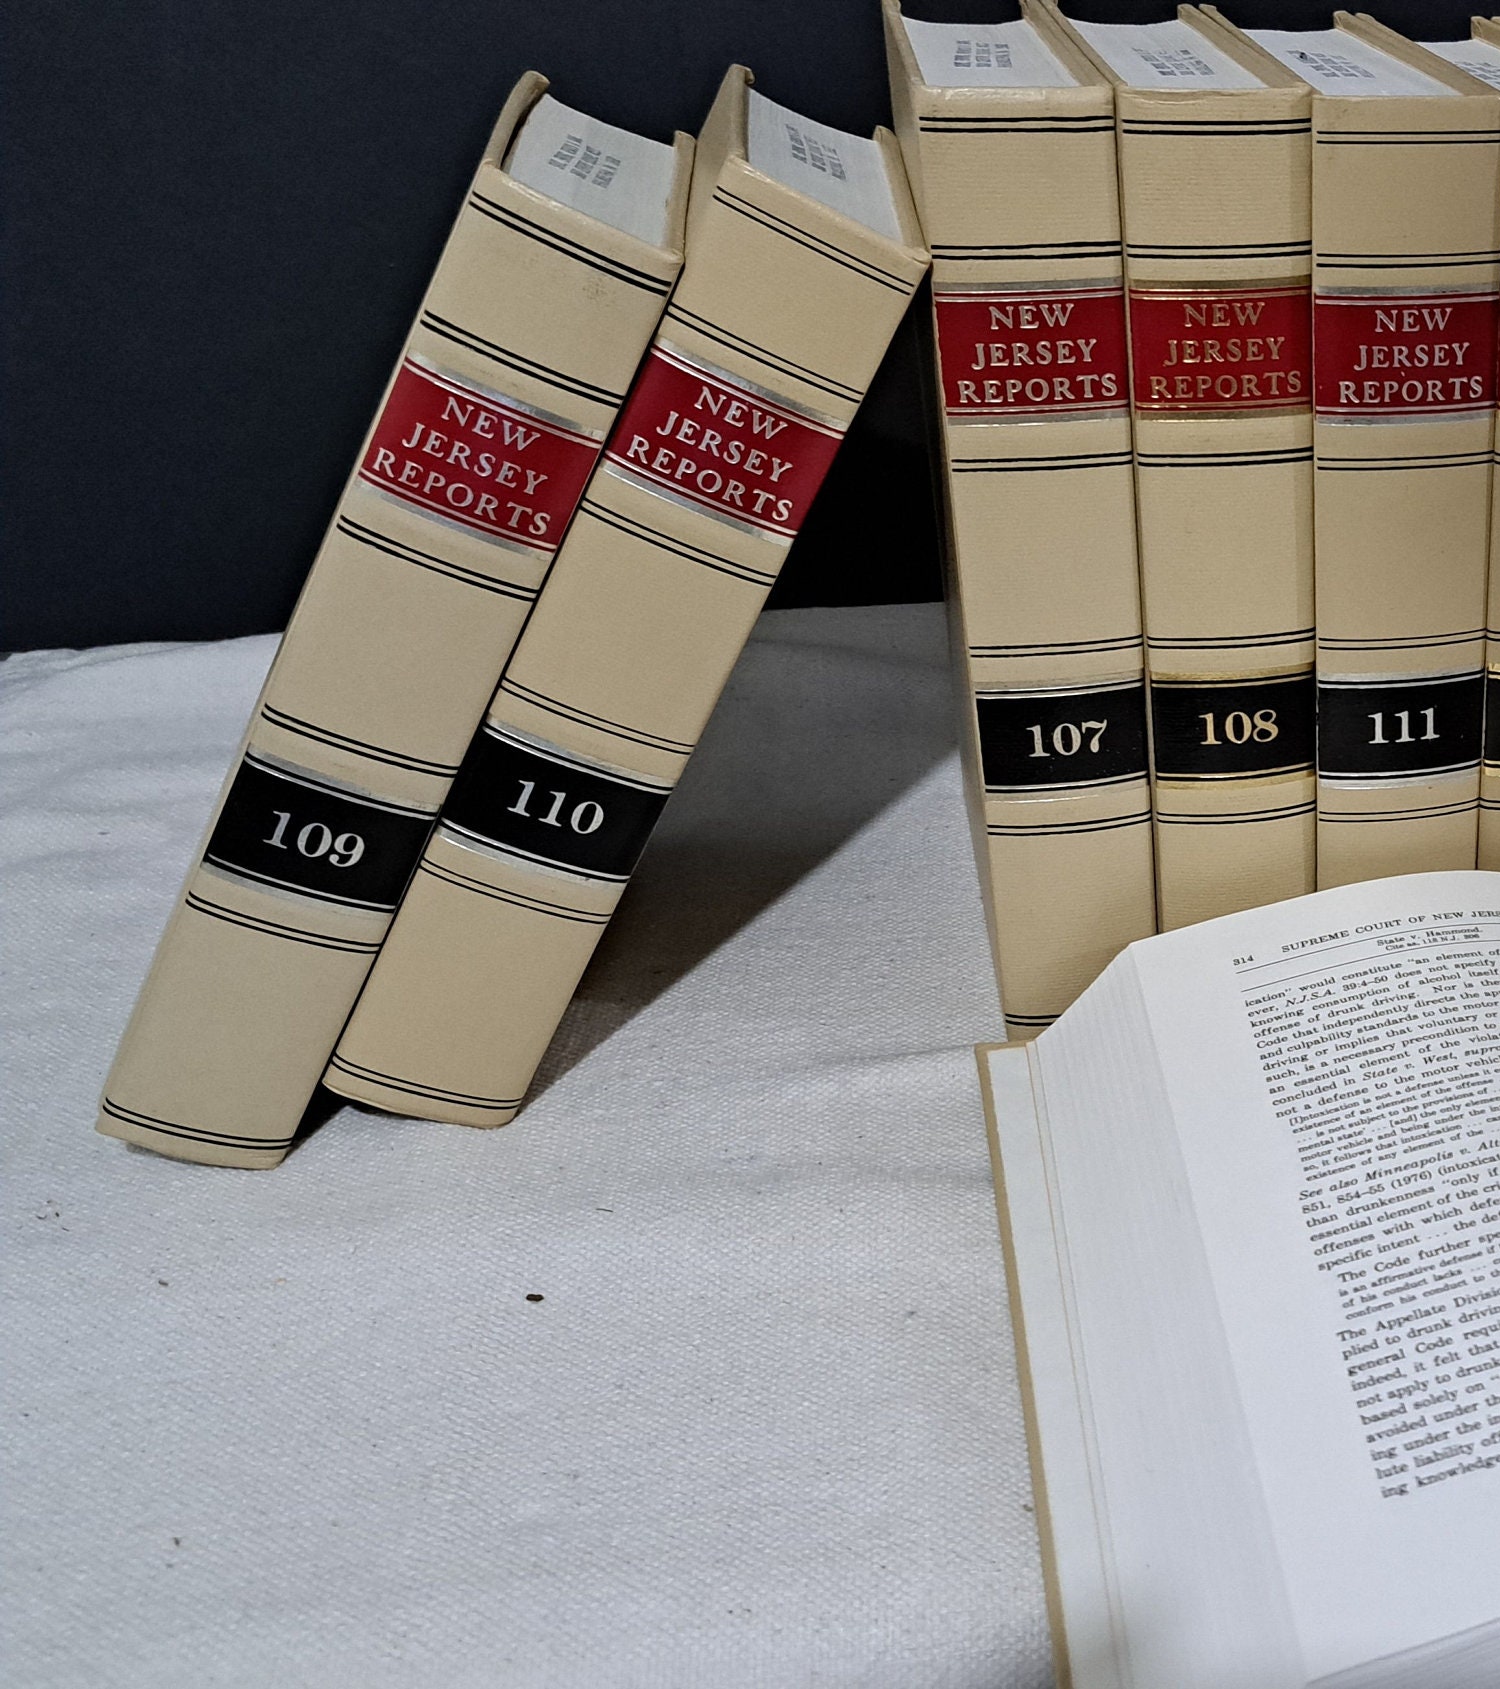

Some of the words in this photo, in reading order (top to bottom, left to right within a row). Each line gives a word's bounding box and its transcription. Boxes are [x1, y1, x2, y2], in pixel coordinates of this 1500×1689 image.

[989, 303, 1074, 330] NEW
[1184, 302, 1265, 327] NEW
[1375, 308, 1452, 332] NEW
[972, 339, 1097, 370] JERSEY
[1163, 337, 1285, 367] JERSEY
[1354, 342, 1470, 370] JERSEY
[958, 373, 1118, 403] REPORTS
[1151, 371, 1301, 398] REPORTS
[1339, 376, 1483, 403] REPORTS
[441, 397, 541, 450] NEW
[694, 386, 789, 440] NEW
[402, 423, 548, 495] JERSEY
[656, 412, 793, 482] JERSEY
[373, 448, 551, 535] REPORTS
[626, 435, 792, 522] REPORTS
[1025, 719, 1107, 758] 107
[1199, 709, 1279, 745] 108
[1368, 707, 1440, 744] 111
[506, 780, 604, 834] 110
[262, 811, 365, 867] 109
[1282, 930, 1349, 953] SUPREME
[1356, 919, 1402, 934] COURT
[1433, 911, 1463, 920] NEW
[1377, 936, 1405, 946] State
[1426, 927, 1483, 937] Hammond.
[1386, 942, 1405, 951] Cite
[1233, 955, 1254, 966] 314
[1299, 977, 1335, 991] would
[1342, 962, 1402, 982] constitute
[1436, 951, 1483, 961] element
[1248, 1006, 1278, 1018] ever,
[1286, 990, 1336, 1007] N.J.S.A.
[1395, 970, 1422, 979] does
[1454, 959, 1496, 970] specify
[1251, 1009, 1305, 1028] knowing
[1312, 986, 1390, 1011] consumption
[1398, 981, 1410, 989] of
[1418, 972, 1460, 985] alcohol
[1468, 968, 1499, 978] itself
[1254, 1021, 1300, 1038] offense
[1307, 1014, 1321, 1023] of
[1328, 1004, 1364, 1018] drunk
[1372, 992, 1420, 1006] driving.
[1433, 985, 1457, 993] Nor
[1299, 1188, 1323, 1200] See
[1330, 1178, 1358, 1192] also
[1366, 1151, 1453, 1182] Minneapolis
[1302, 1201, 1331, 1214] 851,
[1391, 1171, 1432, 1189] (1976)
[1338, 1269, 1367, 1283] The
[1374, 1256, 1410, 1272] Code
[1419, 1239, 1471, 1260] further
[1337, 1328, 1367, 1342] The
[1376, 1304, 1446, 1332] Appellate
[1343, 1339, 1379, 1360] plied
[1386, 1335, 1401, 1345] to
[1407, 1319, 1452, 1339] drunk
